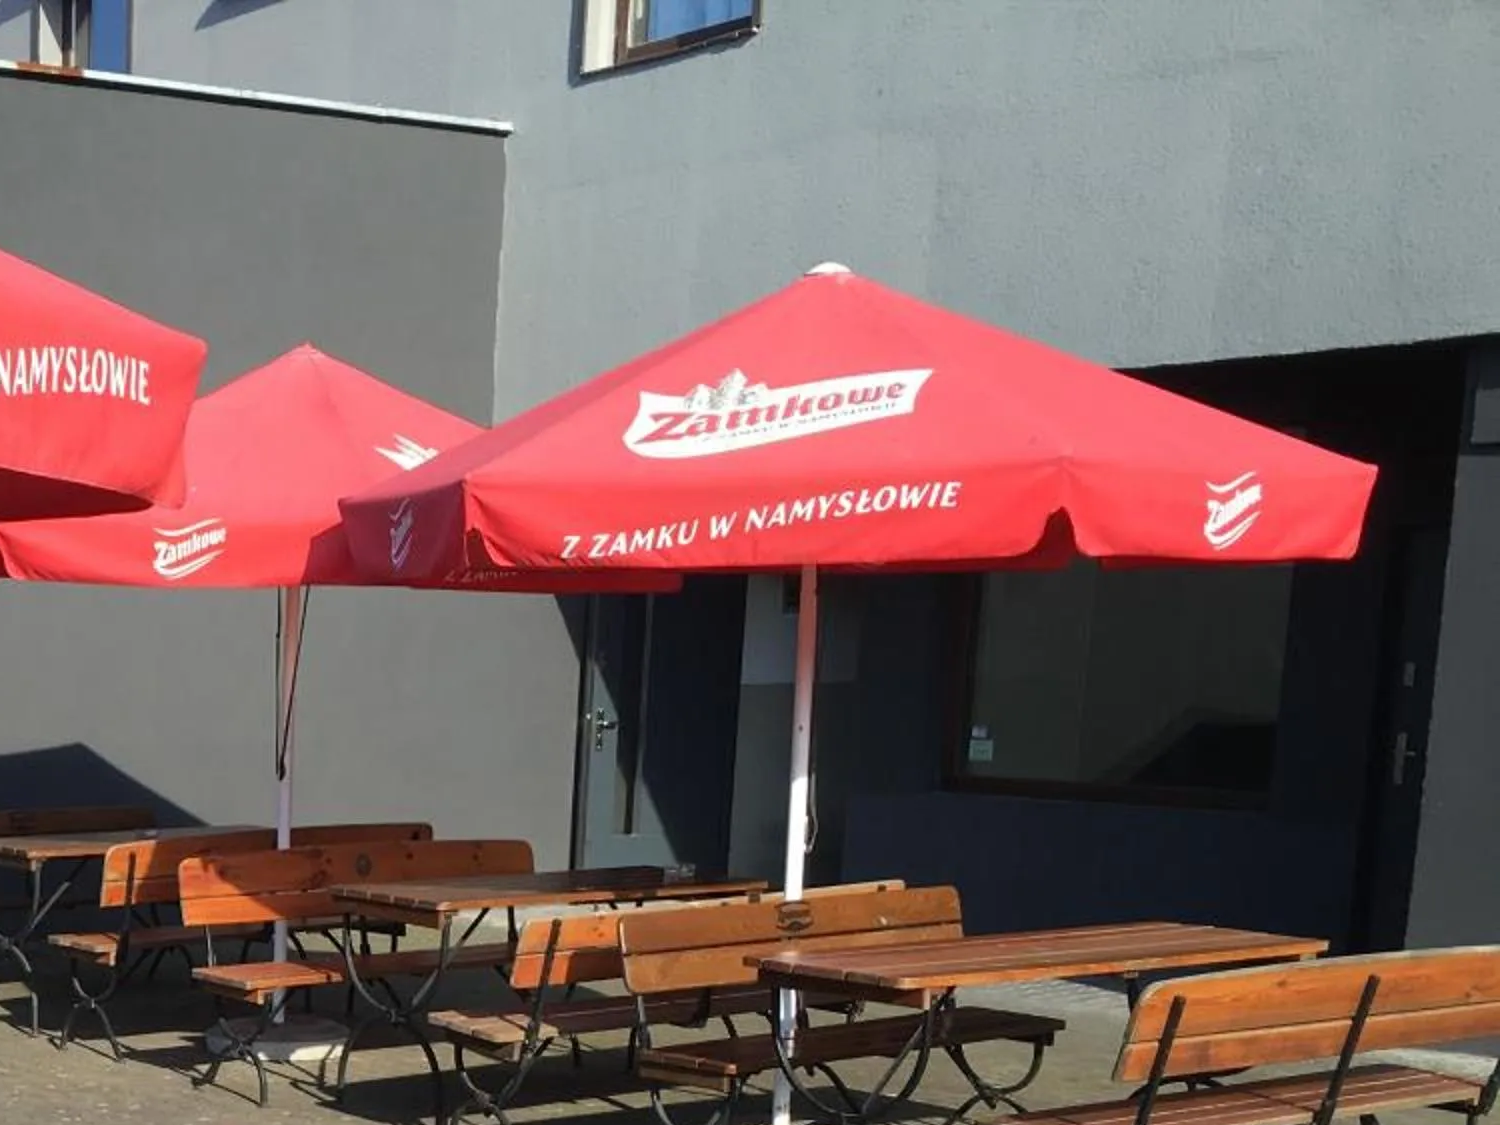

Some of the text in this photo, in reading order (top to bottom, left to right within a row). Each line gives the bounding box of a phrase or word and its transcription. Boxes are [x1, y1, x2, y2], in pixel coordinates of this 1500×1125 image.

[632, 381, 907, 445] Zamkowe
[561, 481, 962, 559] Z ZAMKU W NAMYSŁOWIE
